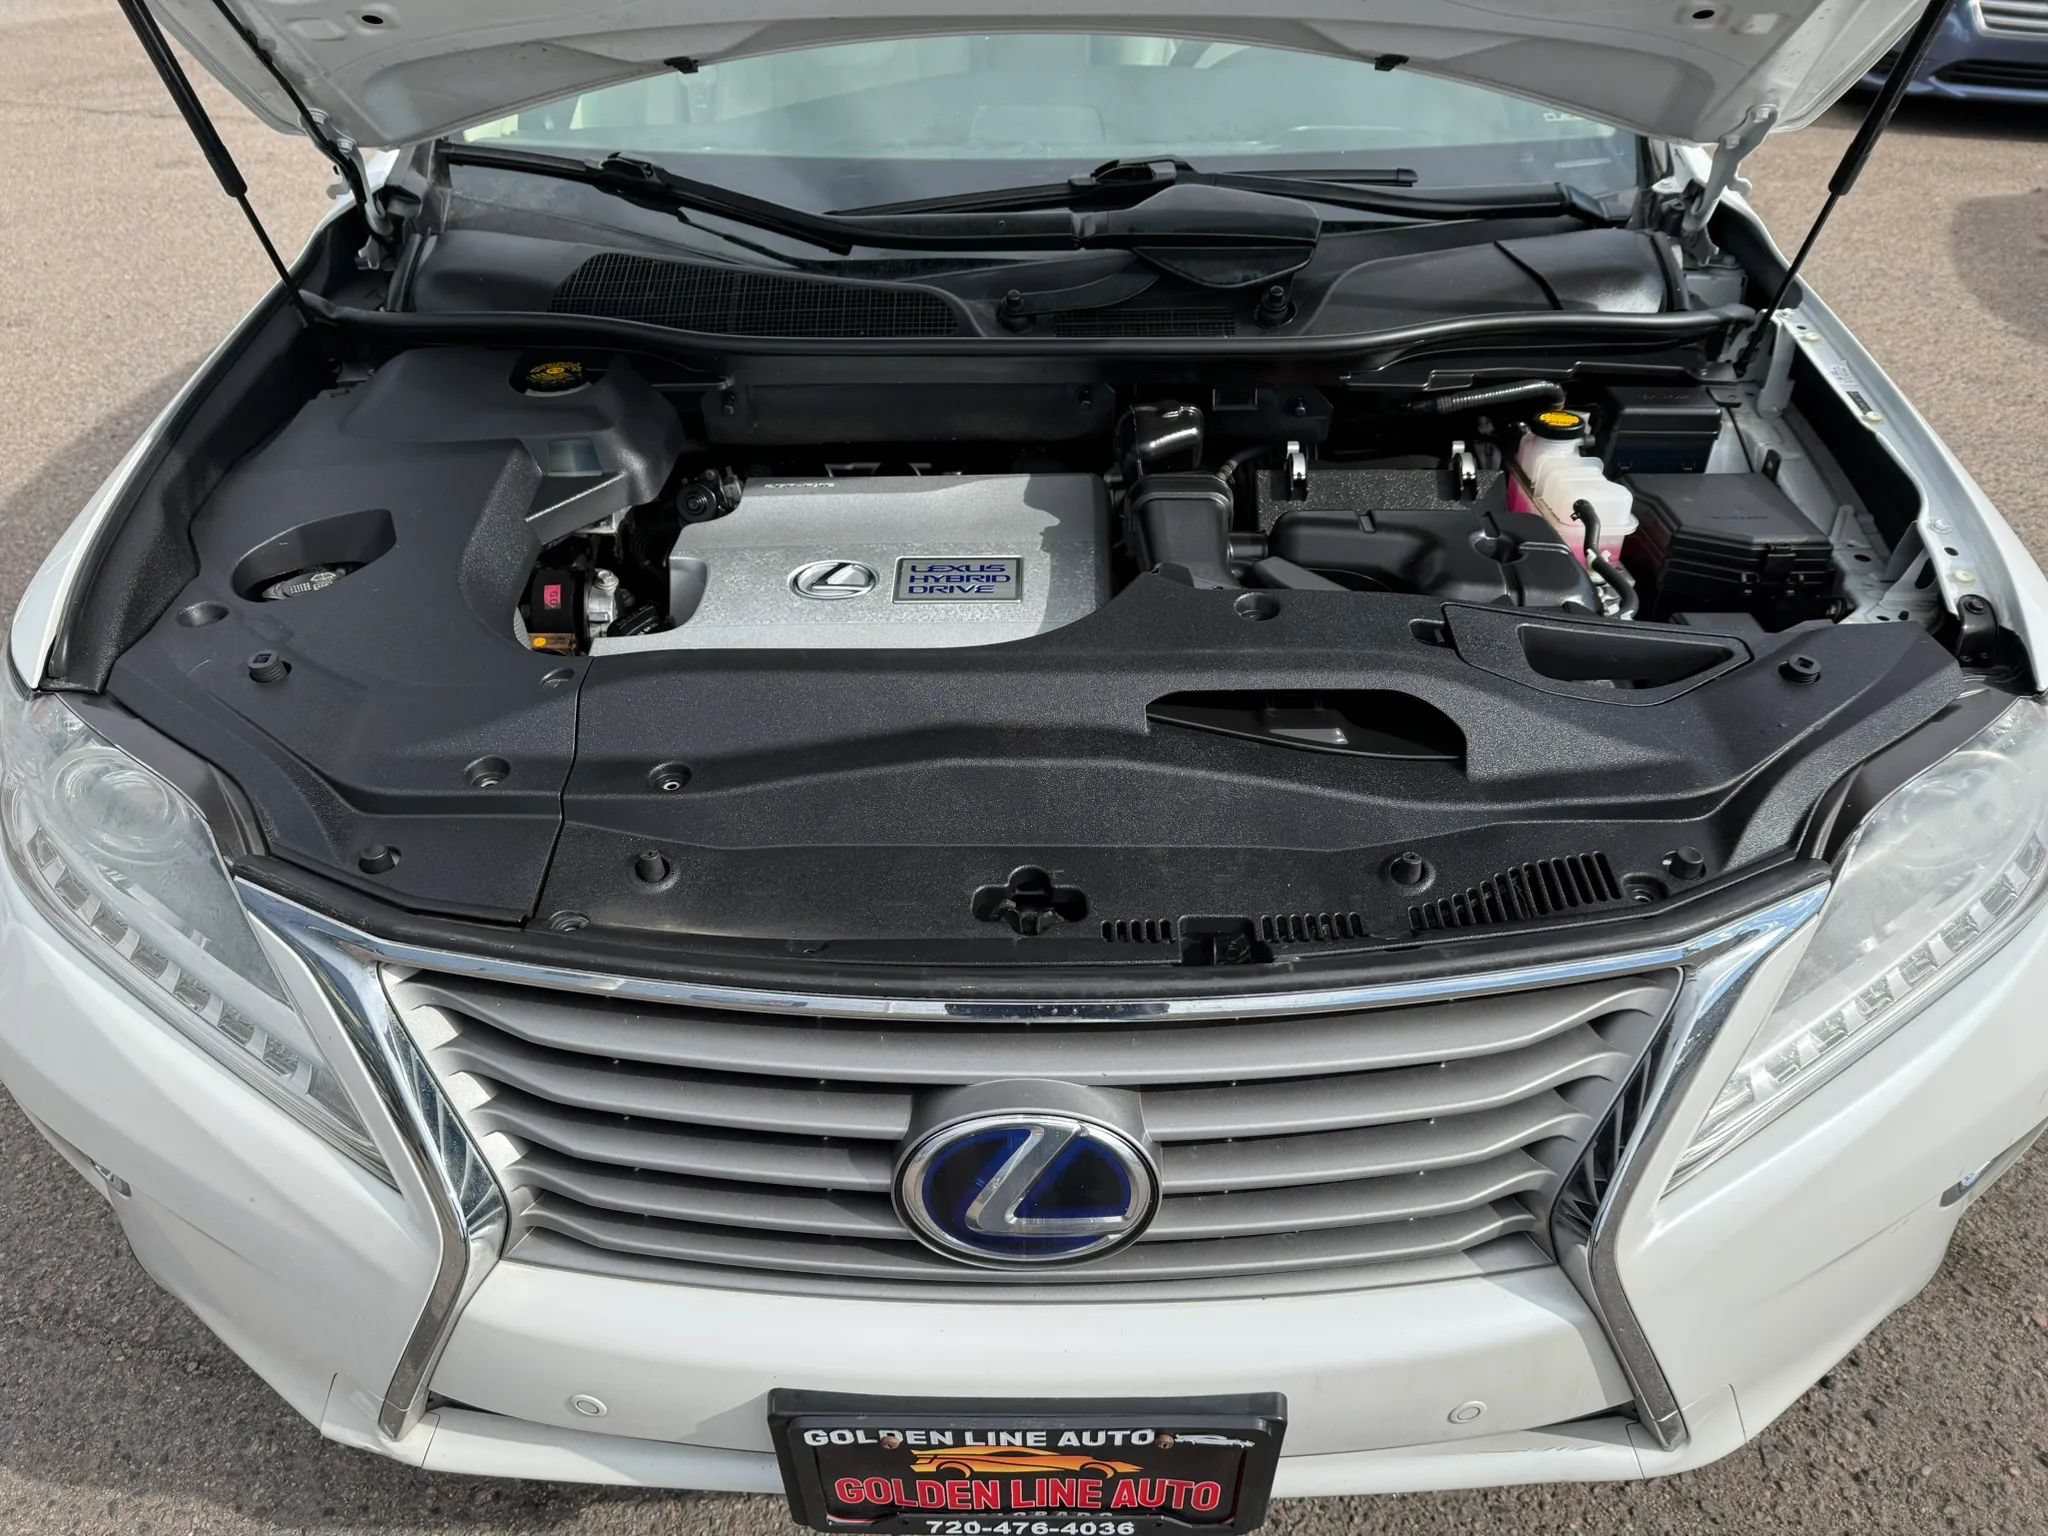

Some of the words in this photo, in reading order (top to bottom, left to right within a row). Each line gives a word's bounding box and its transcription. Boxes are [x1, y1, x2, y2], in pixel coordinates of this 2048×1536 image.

[911, 564, 1006, 573] LEXUS
[909, 574, 1012, 584] HYBRID
[908, 585, 996, 594] DRIVE
[965, 1429, 1047, 1446] LINE
[1057, 1428, 1155, 1446] AUTO
[834, 1477, 1000, 1509] GOLDEN
[1010, 1478, 1102, 1508] LINE
[1110, 1477, 1221, 1511] AUTO
[925, 1520, 1135, 1536] 720-476-4036
